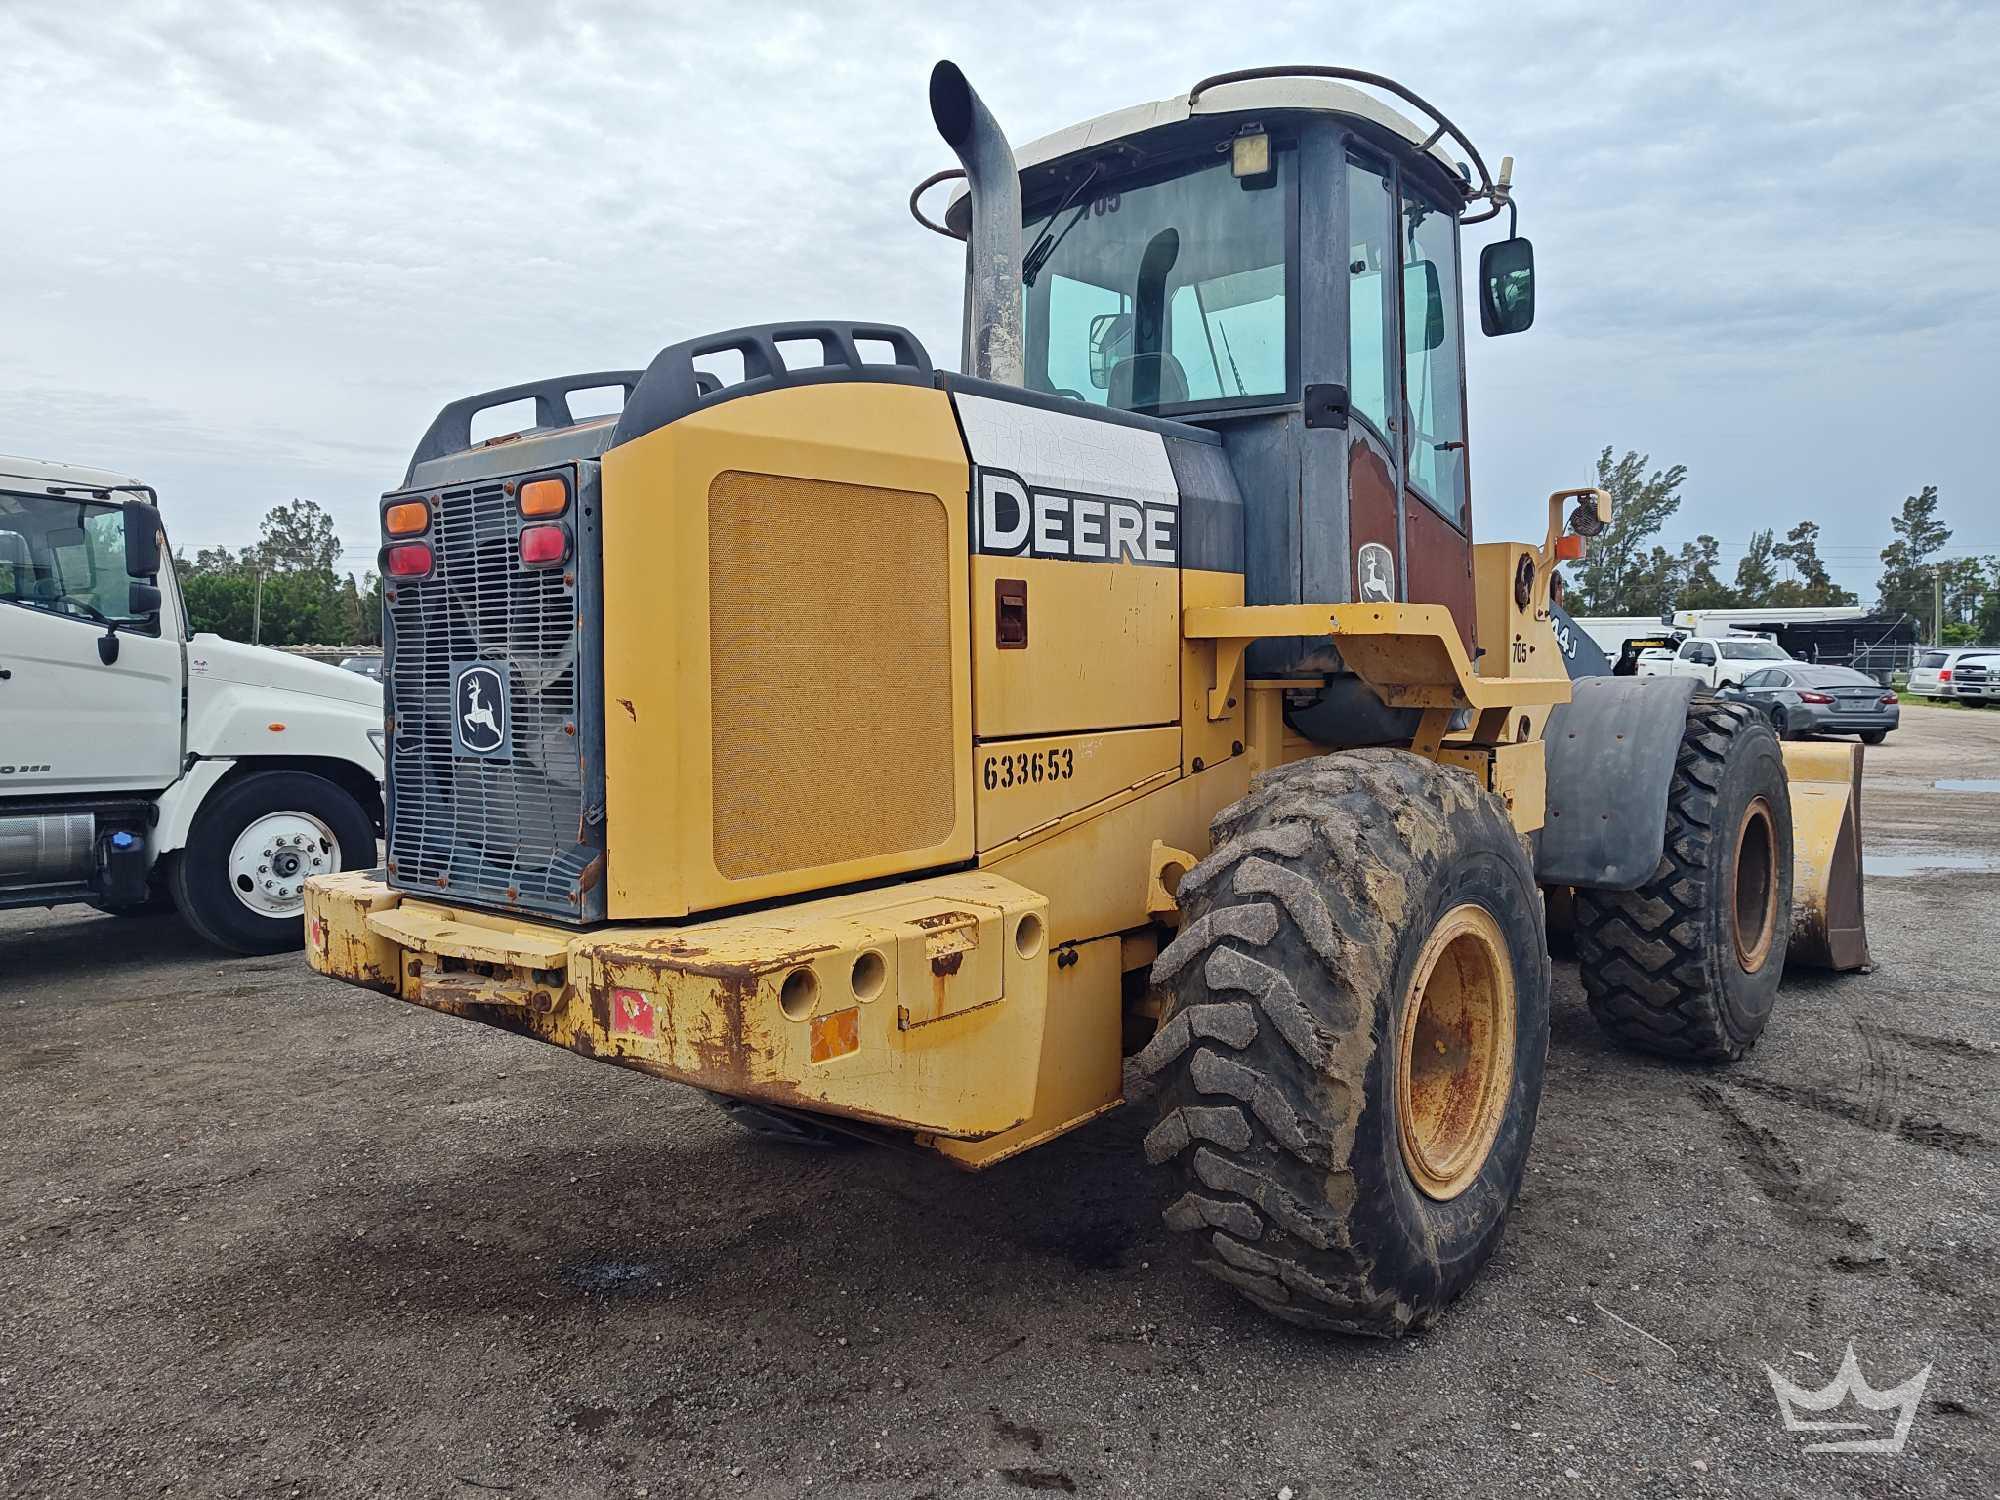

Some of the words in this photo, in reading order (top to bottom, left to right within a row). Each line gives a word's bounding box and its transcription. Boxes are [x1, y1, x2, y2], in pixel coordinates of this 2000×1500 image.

[982, 474, 1176, 563] DEERE
[1512, 642, 1527, 663] 705
[983, 748, 1074, 791] 633653
